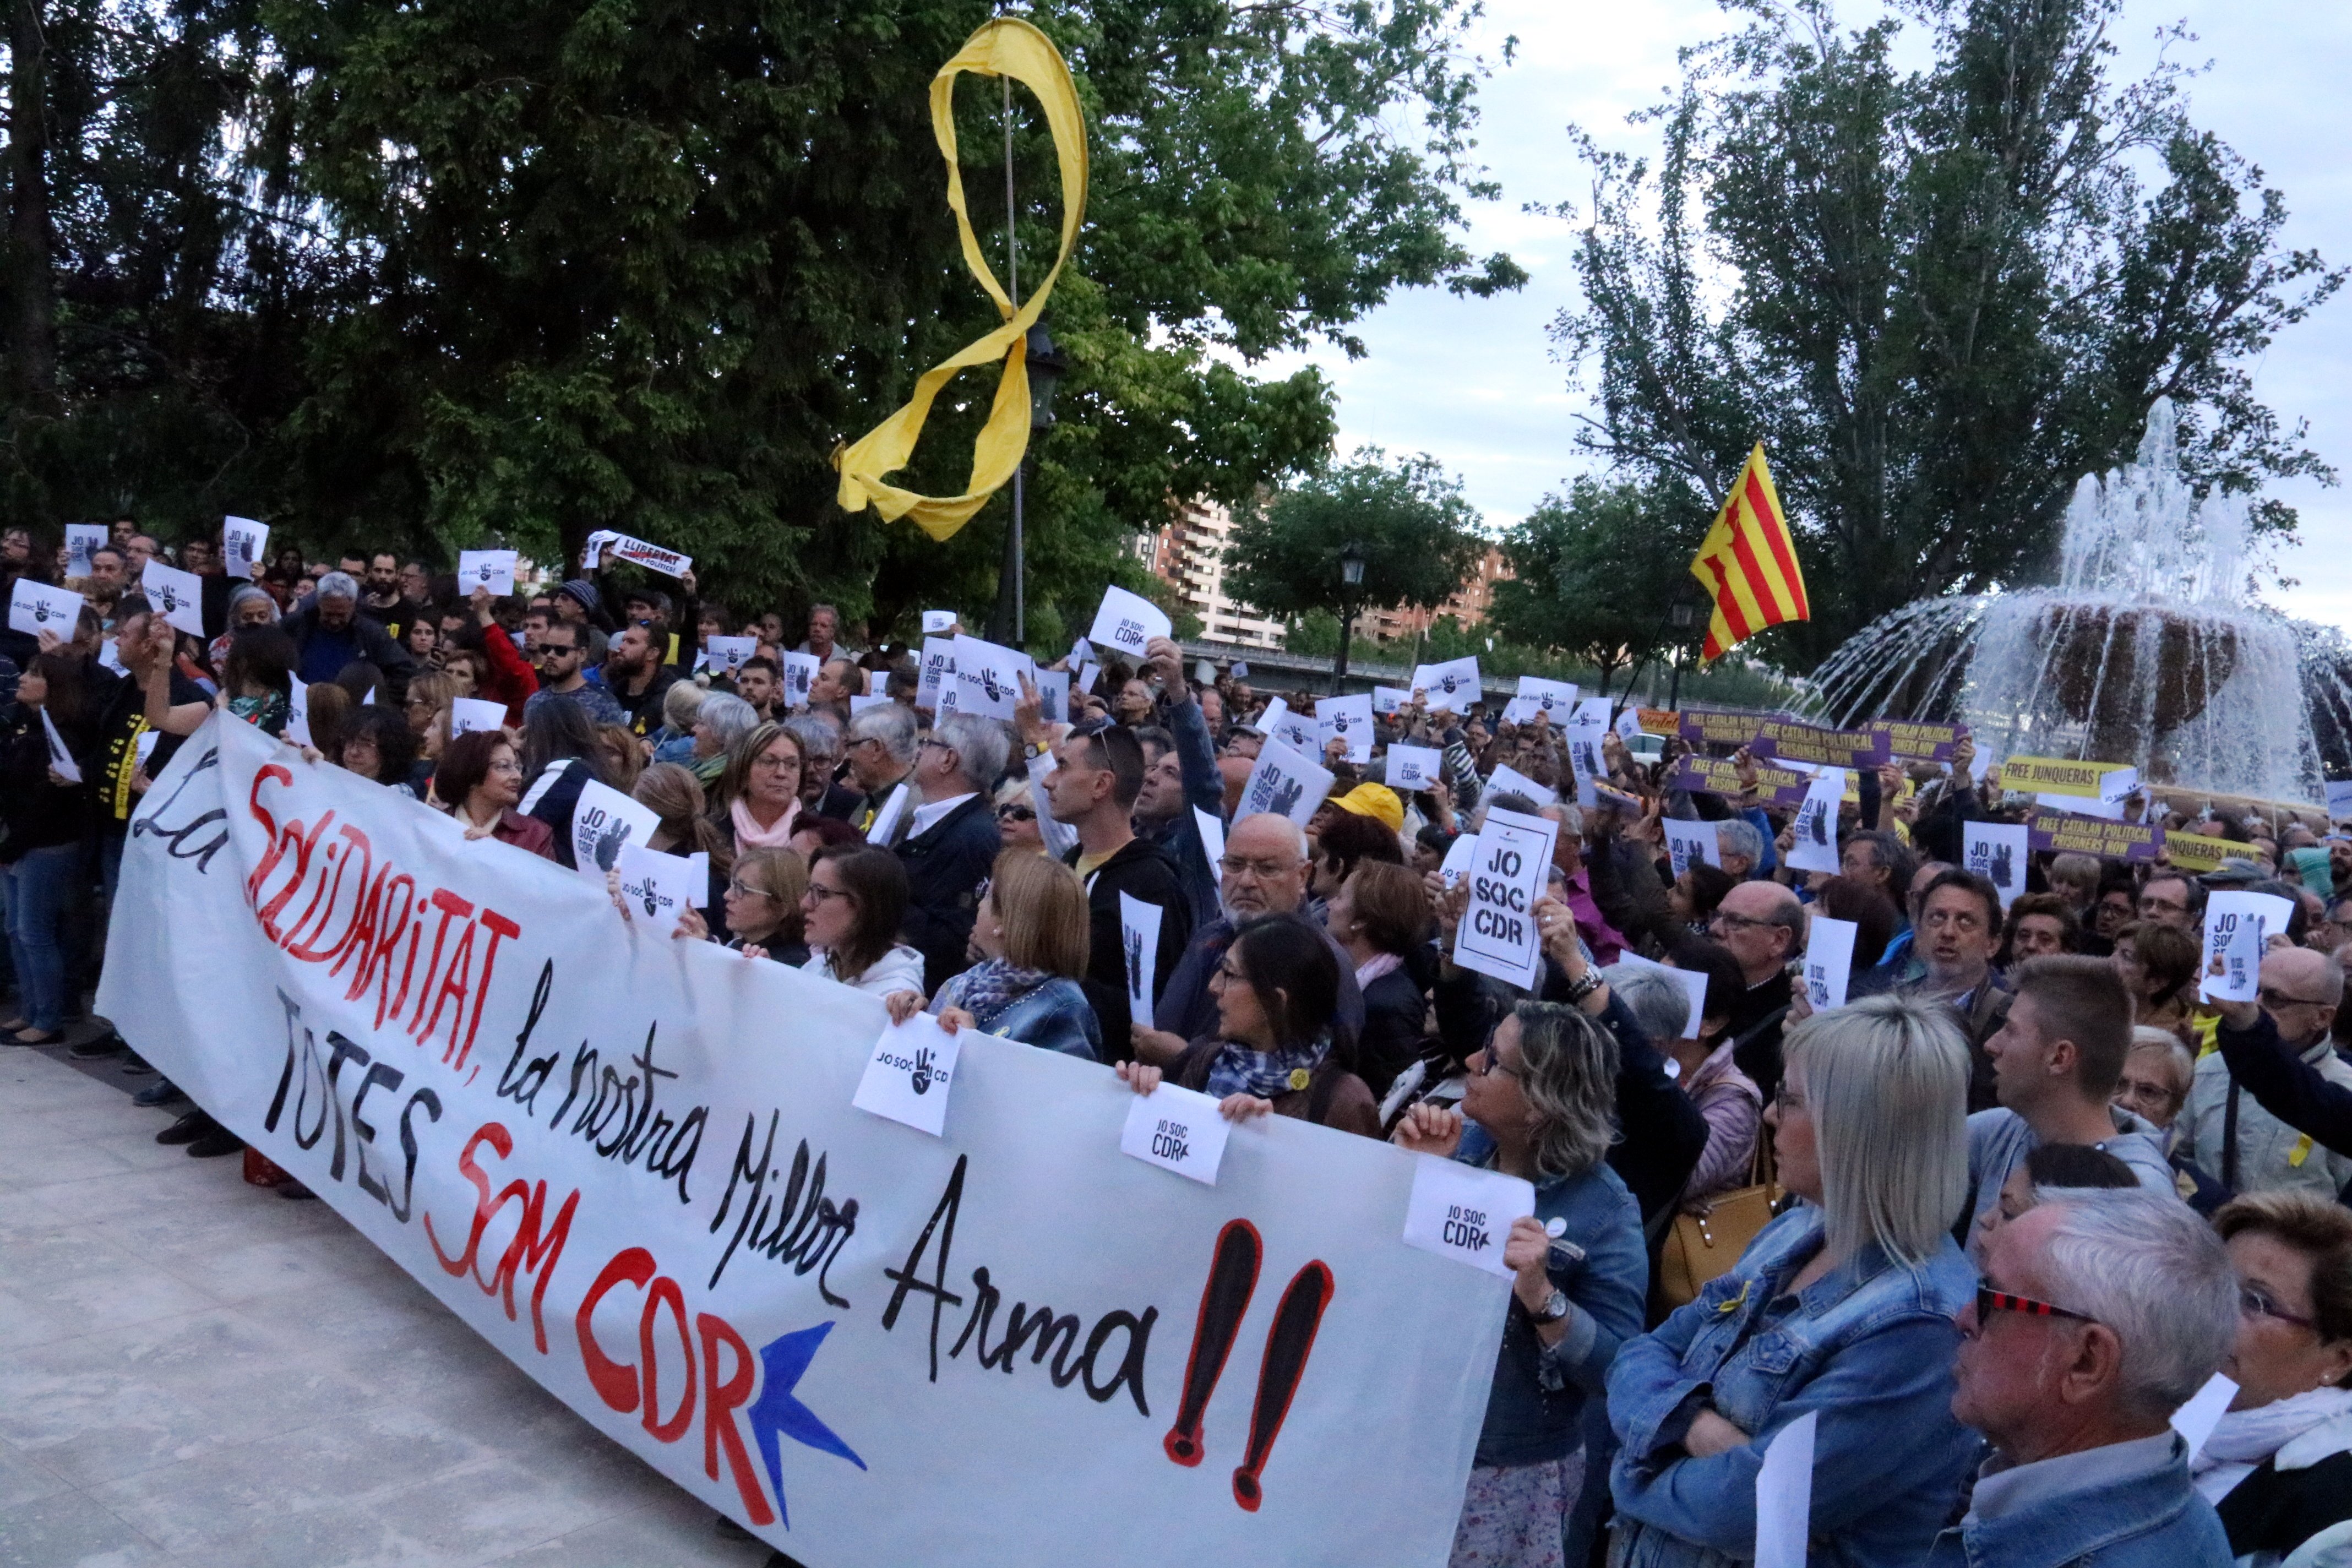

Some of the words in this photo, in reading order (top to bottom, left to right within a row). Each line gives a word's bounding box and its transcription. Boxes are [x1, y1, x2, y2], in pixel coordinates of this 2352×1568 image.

[1120, 618, 1130, 628] JO
[1130, 620, 1145, 632] SOC
[1115, 627, 1139, 646] CDR
[787, 664, 796, 674] JO
[929, 654, 944, 667] JO
[925, 675, 940, 684] CDR
[927, 667, 942, 677] SOC
[957, 671, 967, 680] JO
[967, 674, 983, 686] SOC
[999, 685, 1016, 696] CDR
[943, 691, 956, 706] JO
[1260, 762, 1281, 786] JO
[1402, 769, 1419, 781] CDR
[2005, 762, 2030, 778] FREE
[2031, 765, 2095, 786] JUNQUERAS
[1256, 778, 1273, 798] SOC
[1250, 790, 1268, 812] CDR
[1801, 797, 1813, 813] JO
[581, 806, 607, 828] JO
[579, 824, 597, 843] SOC
[2036, 816, 2060, 832] FREE
[2061, 819, 2103, 836] CATALAN
[2103, 823, 2152, 843] POLITICAL
[1672, 838, 1684, 853] JO
[1971, 841, 1989, 857] JO
[1442, 868, 1453, 878] JO
[1488, 848, 1522, 878] JO
[1971, 858, 1989, 869] SOC
[631, 885, 644, 899] SOC
[658, 895, 674, 908] CDR
[1476, 876, 1525, 914] SOC
[1475, 909, 1523, 946] CDR
[2214, 913, 2237, 933] JO
[876, 1052, 892, 1065] JO
[893, 1056, 914, 1072] SOC
[133, 746, 231, 874] La
[497, 957, 562, 1117] la
[551, 1020, 709, 1204] nostra
[708, 1108, 859, 1309] Millor
[883, 1153, 1159, 1417] Arma
[1157, 1119, 1168, 1133] JO
[1169, 1122, 1188, 1139] SOC
[1152, 1133, 1183, 1162] CDR
[1447, 1205, 1461, 1219] JO
[1463, 1208, 1486, 1227] SOC
[1444, 1220, 1481, 1251] CDR
[265, 986, 442, 1223] TOTES
[424, 1121, 580, 1354] SOM
[575, 1246, 775, 1526] CDR
